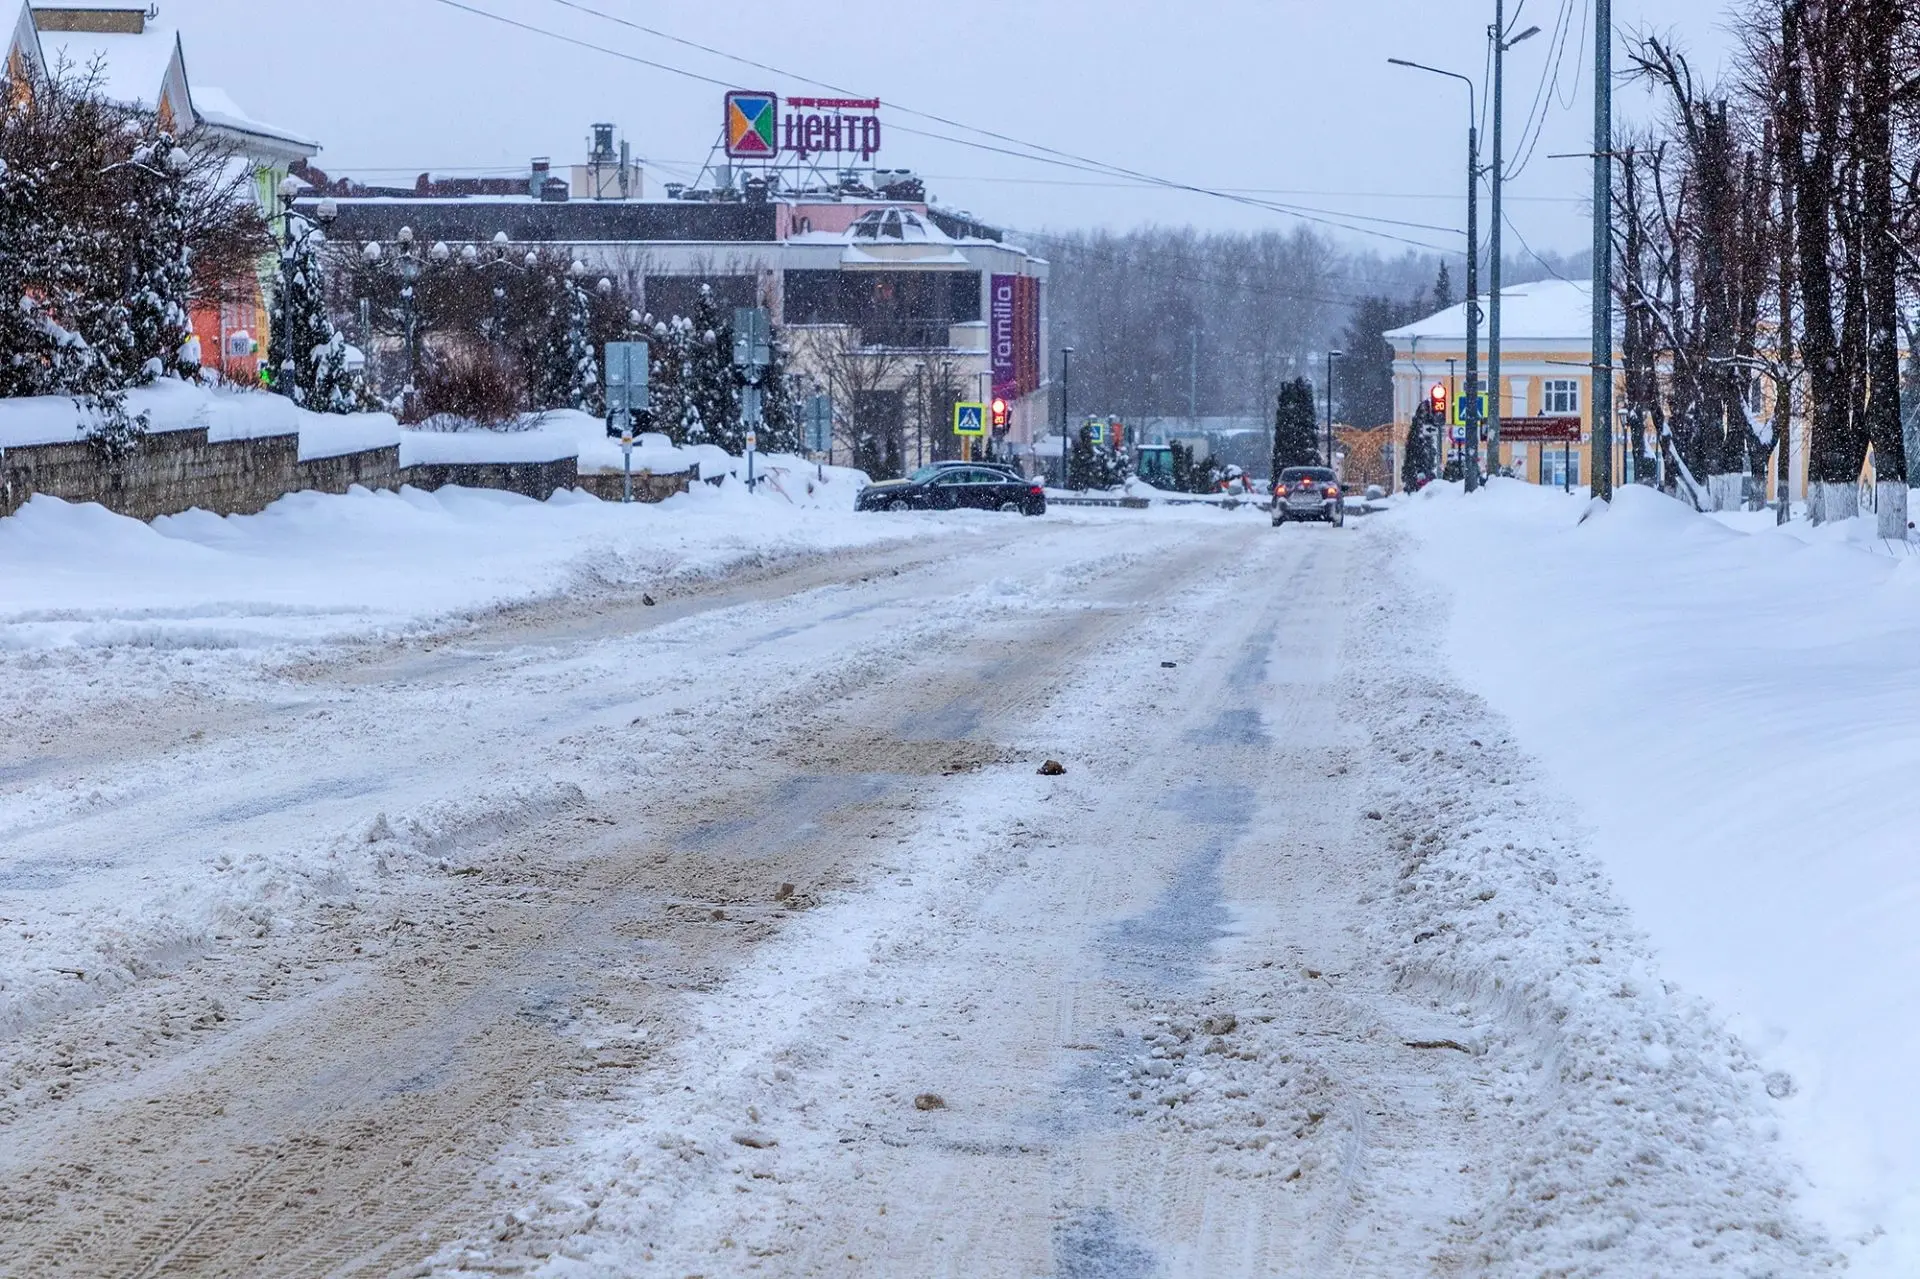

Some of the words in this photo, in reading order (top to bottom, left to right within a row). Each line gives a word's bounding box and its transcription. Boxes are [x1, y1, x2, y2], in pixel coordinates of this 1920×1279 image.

[785, 114, 880, 161] центр
[993, 286, 1012, 366] familia
[1435, 401, 1445, 411] 20
